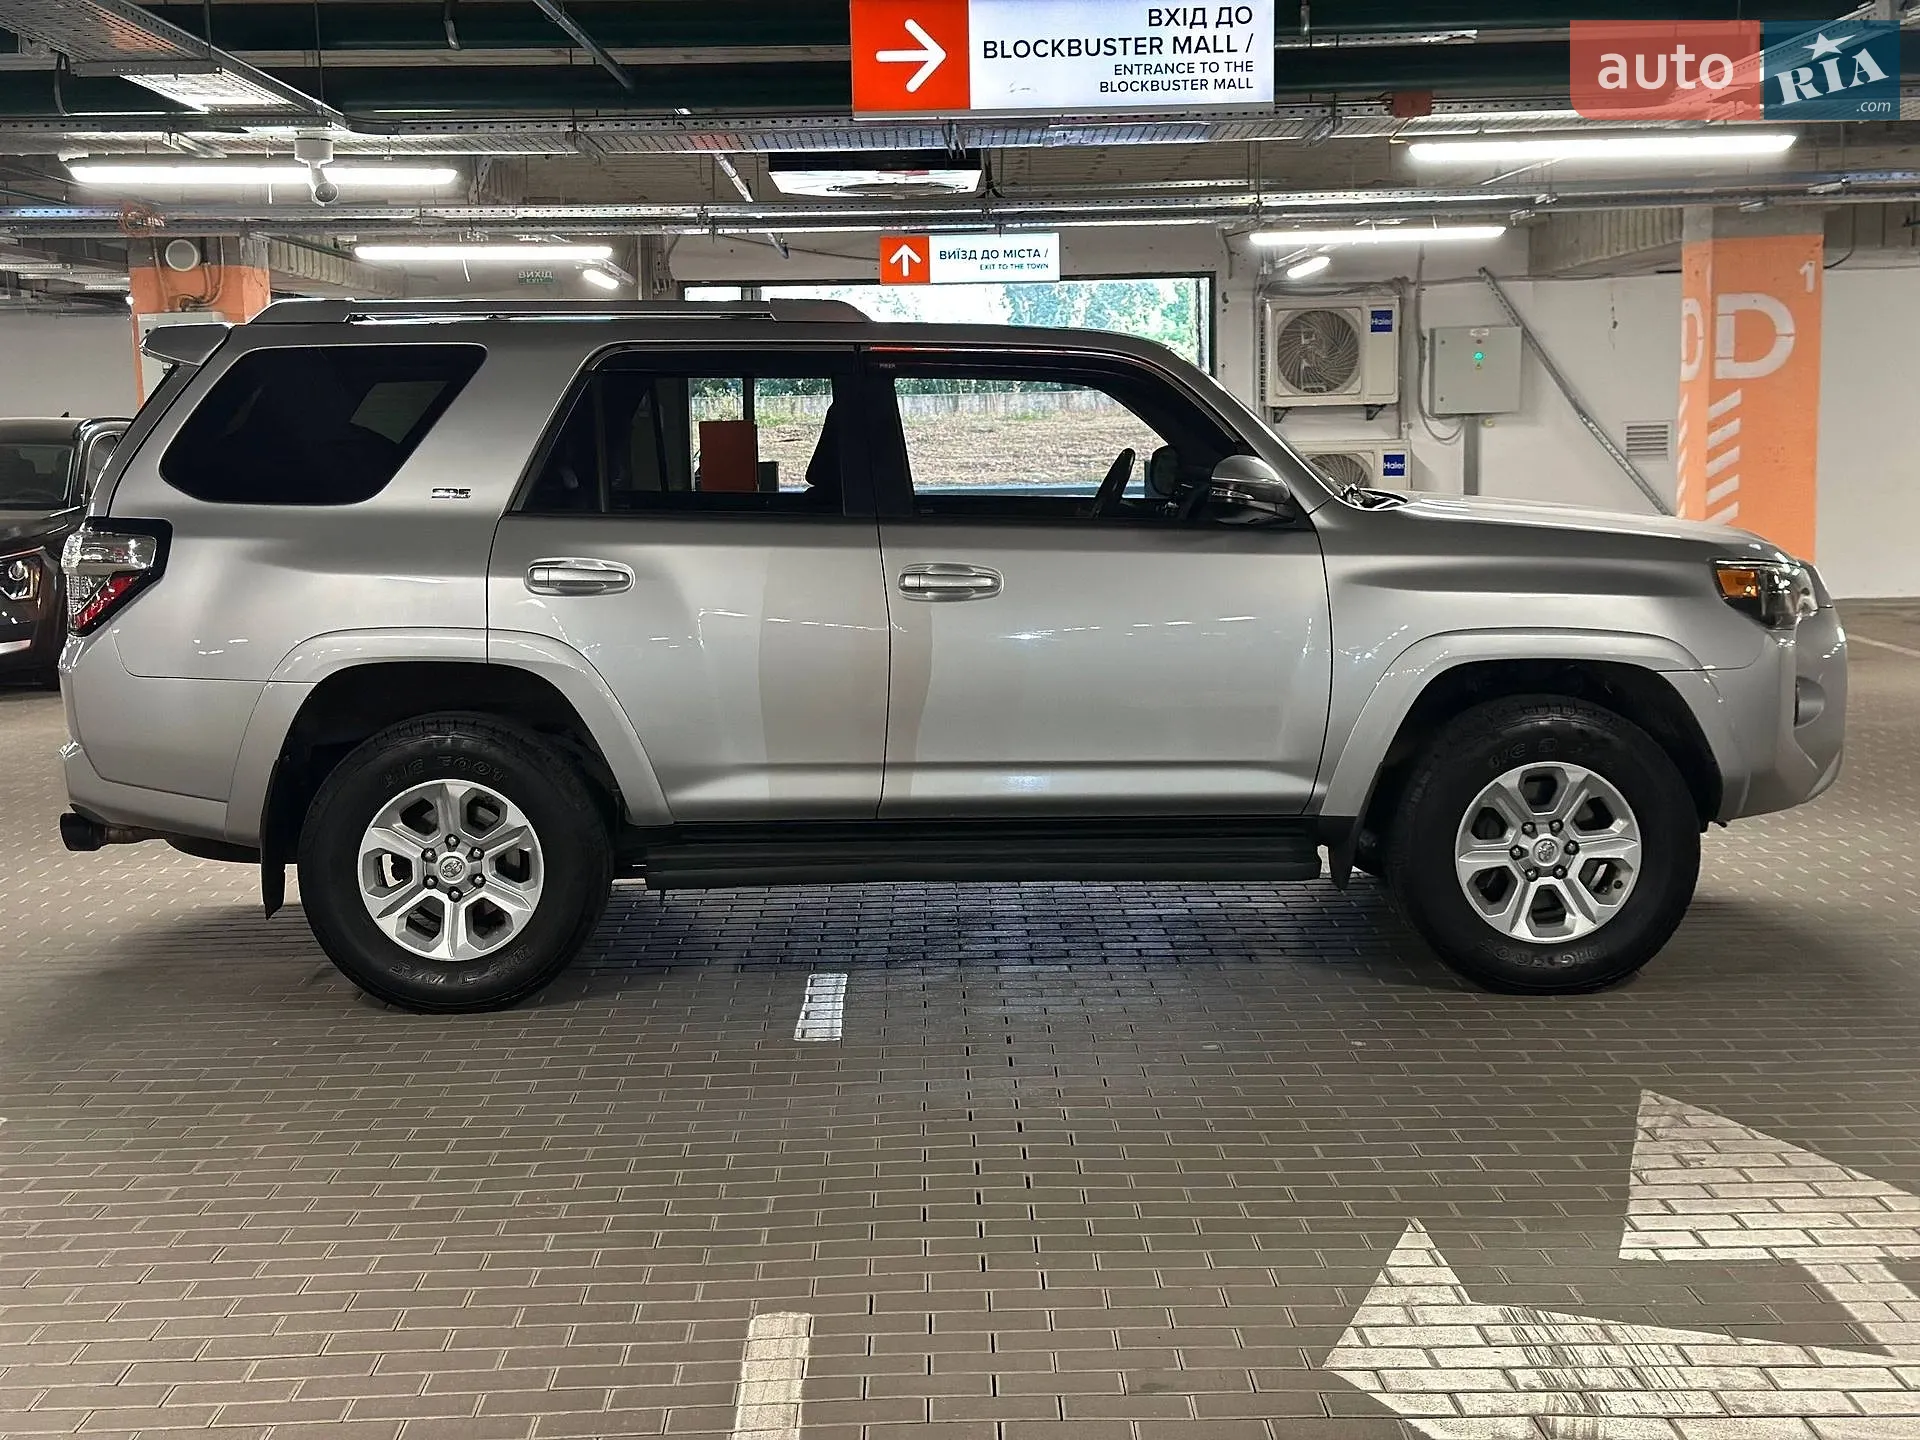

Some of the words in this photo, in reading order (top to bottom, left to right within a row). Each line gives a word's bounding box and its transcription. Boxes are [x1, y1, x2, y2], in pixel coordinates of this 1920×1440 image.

[1148, 7, 1208, 29] ВХІД
[1215, 6, 1253, 28] ДО
[983, 36, 1164, 59] BLOCKBUSTER
[1172, 34, 1238, 55] MALL
[1114, 62, 1195, 76] ENTRANCE
[1200, 62, 1219, 73] TO
[1224, 60, 1254, 73] THE
[1099, 79, 1209, 93] BLOCKBUSTER
[1213, 78, 1254, 90] MALL
[939, 248, 977, 260] ВИЇЗД
[981, 249, 999, 259] ДО
[1003, 248, 1041, 259] МІСТА
[1799, 260, 1816, 293] 1
[1715, 293, 1796, 379] D
